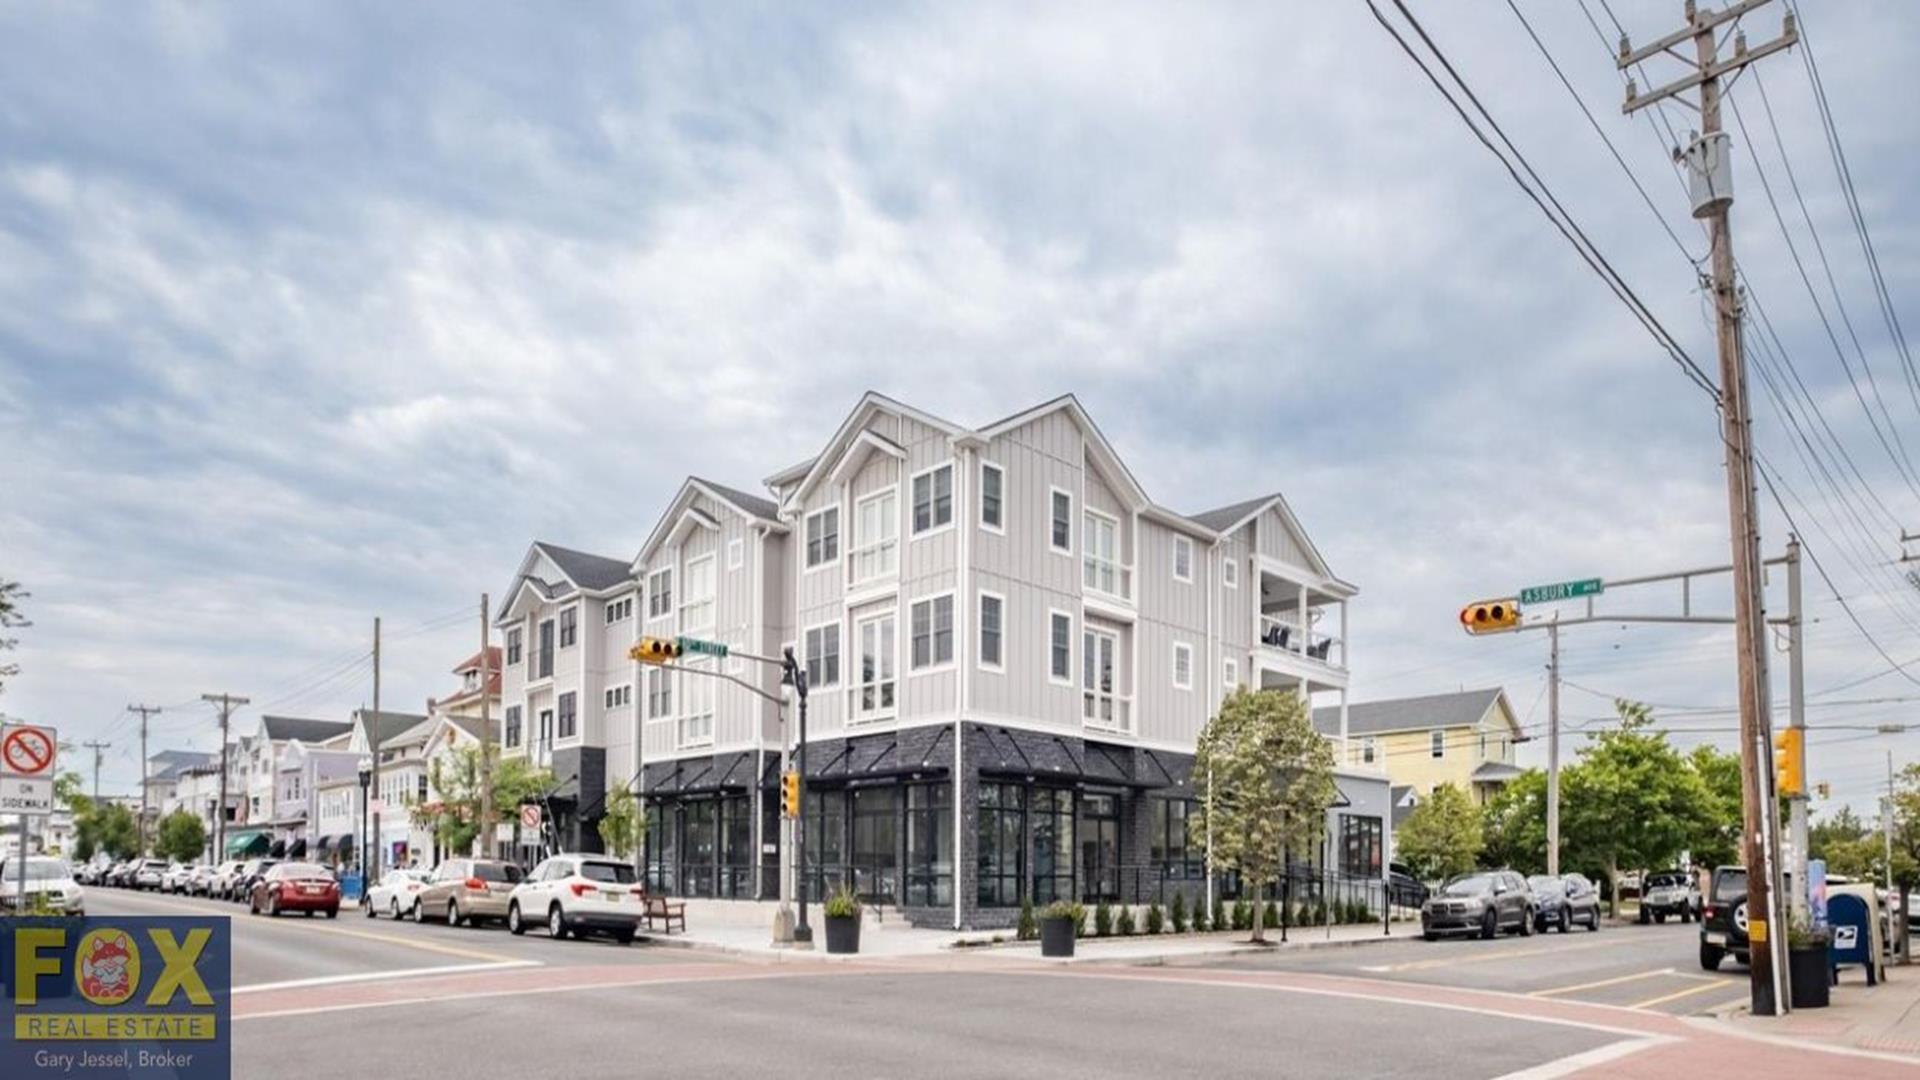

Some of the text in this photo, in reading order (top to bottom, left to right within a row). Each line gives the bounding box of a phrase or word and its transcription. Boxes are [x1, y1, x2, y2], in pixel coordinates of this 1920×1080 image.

[1525, 584, 1574, 601] ASBURY
[19, 783, 33, 794] ON
[2, 797, 49, 809] SIDEWALK
